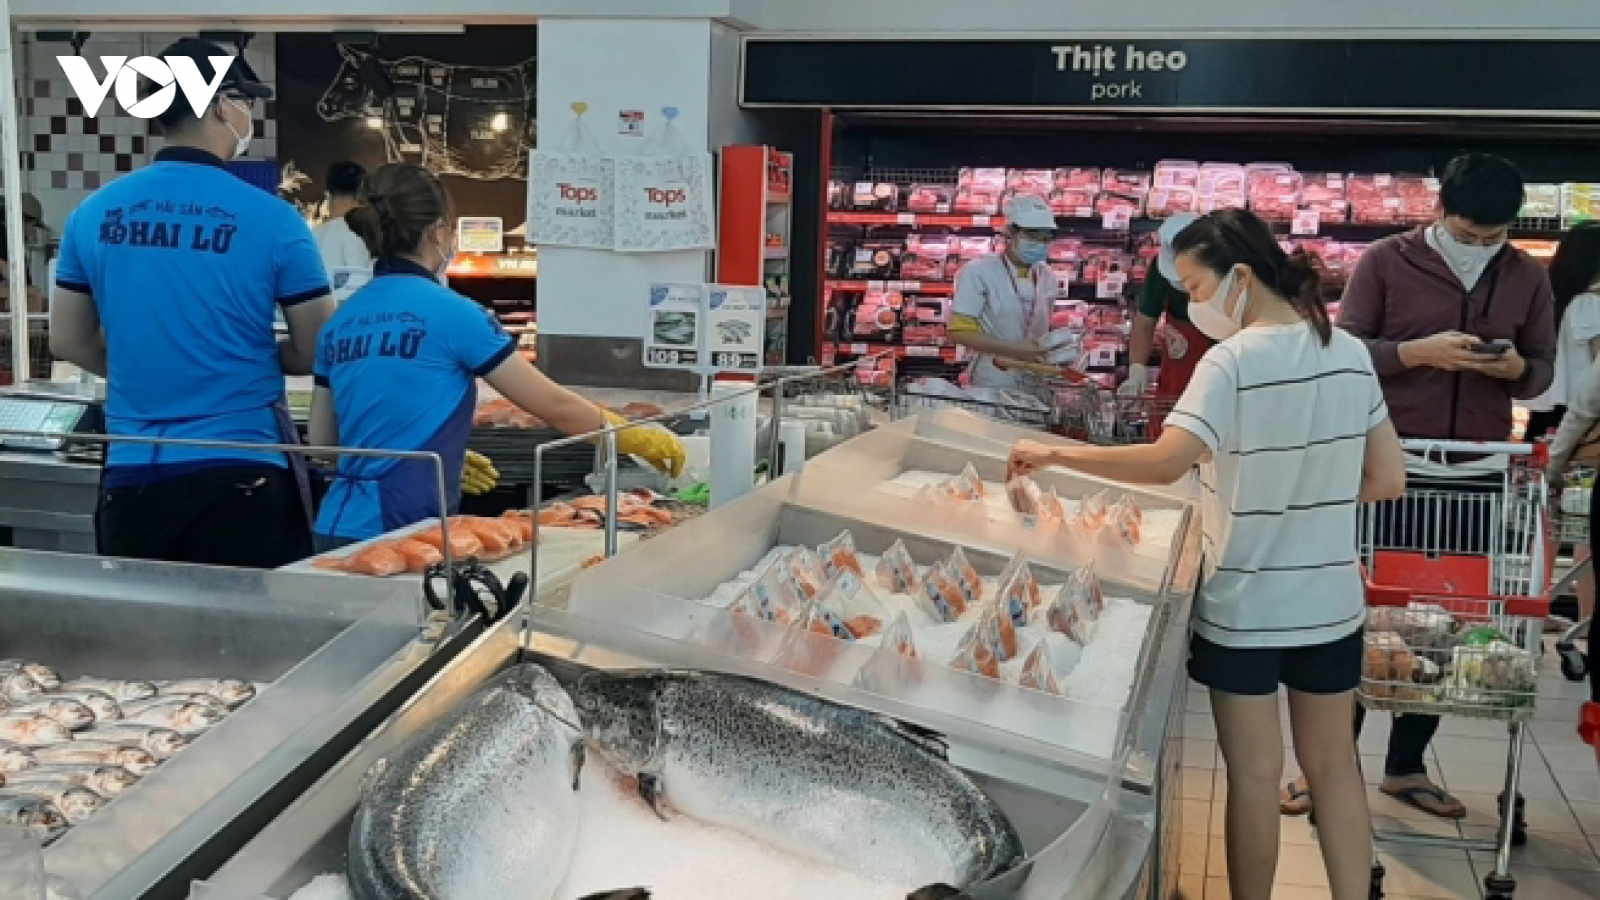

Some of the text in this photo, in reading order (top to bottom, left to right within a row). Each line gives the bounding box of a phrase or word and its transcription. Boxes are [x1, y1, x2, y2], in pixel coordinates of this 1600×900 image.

[1051, 44, 1188, 76] Thịt heo
[1091, 80, 1143, 100] pork
[555, 182, 599, 206] Tops
[643, 187, 687, 208] Tops
[129, 221, 181, 249] HAI
[337, 332, 374, 364] HAI
